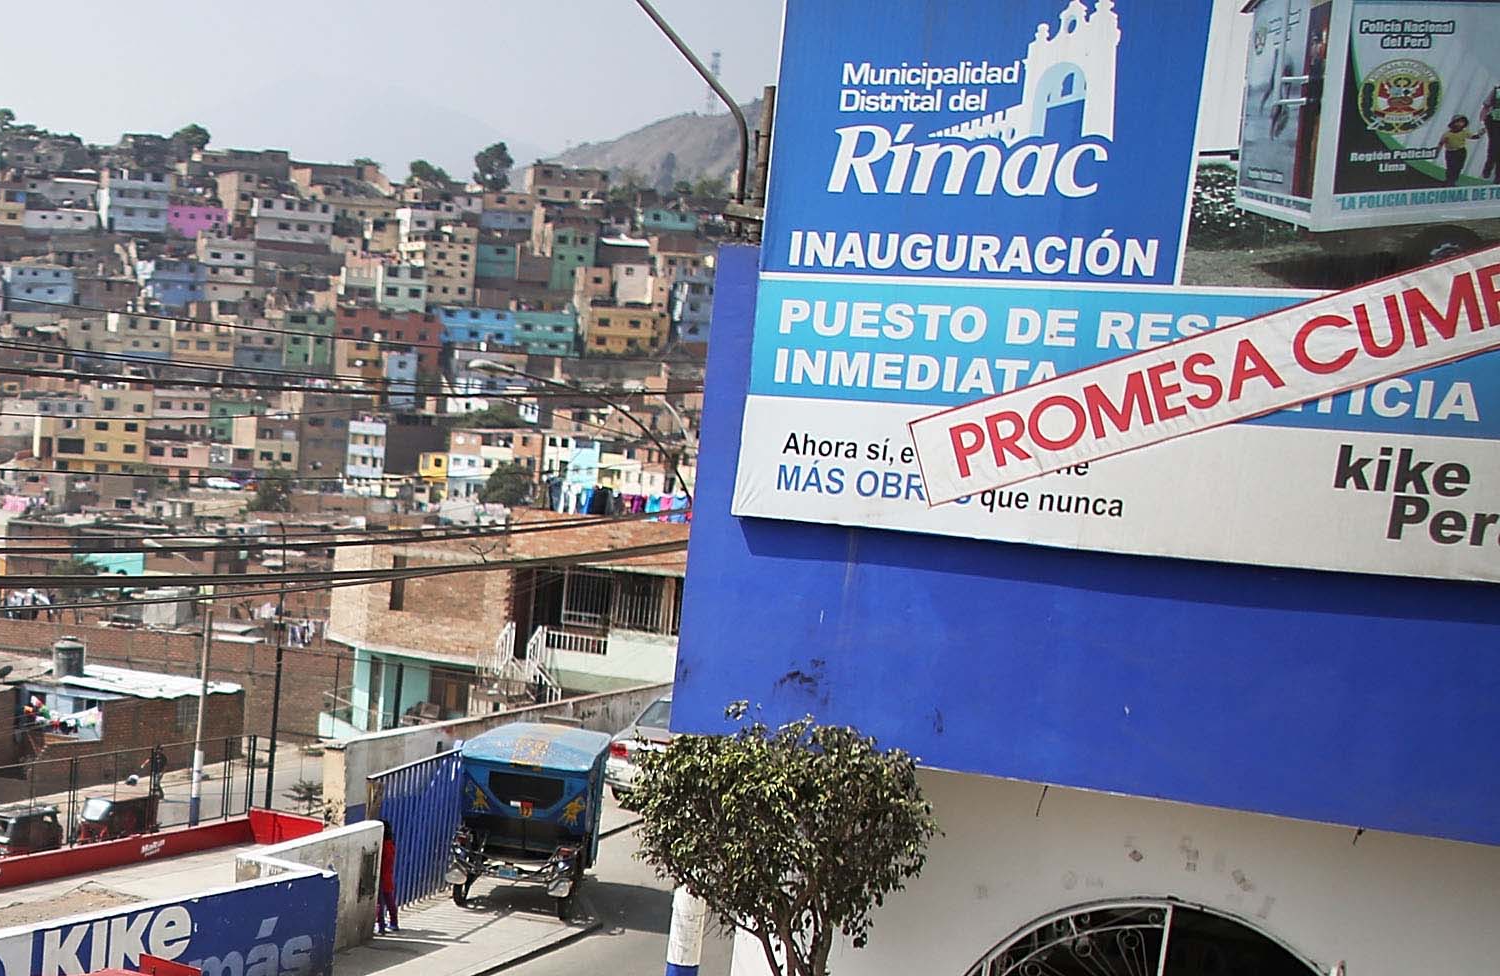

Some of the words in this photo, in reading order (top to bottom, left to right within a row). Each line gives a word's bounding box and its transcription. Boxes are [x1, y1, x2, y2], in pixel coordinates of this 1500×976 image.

[1382, 35, 1401, 47] del
[1403, 21, 1453, 33] Nacional
[841, 60, 1020, 91] Municipalidad
[838, 88, 942, 113] Distrital
[947, 87, 989, 113] del
[826, 123, 1109, 198] Rímac
[1350, 150, 1391, 163] Región
[1393, 148, 1437, 161] Policial
[1378, 162, 1406, 173] Lima
[1410, 188, 1469, 206] NACIONAL
[1472, 186, 1486, 202] DE
[787, 229, 1159, 277] INAUGURACIÓN
[778, 299, 988, 343] PUESTO
[1004, 307, 1080, 348] DE
[1096, 311, 1246, 351] RES
[949, 338, 1286, 478] PROMESA
[782, 431, 858, 460] Ahora
[866, 437, 895, 466] sí,
[1333, 444, 1472, 498] kike
[776, 459, 845, 495] MÁS
[980, 488, 1029, 514] que
[1038, 492, 1124, 518] nunca
